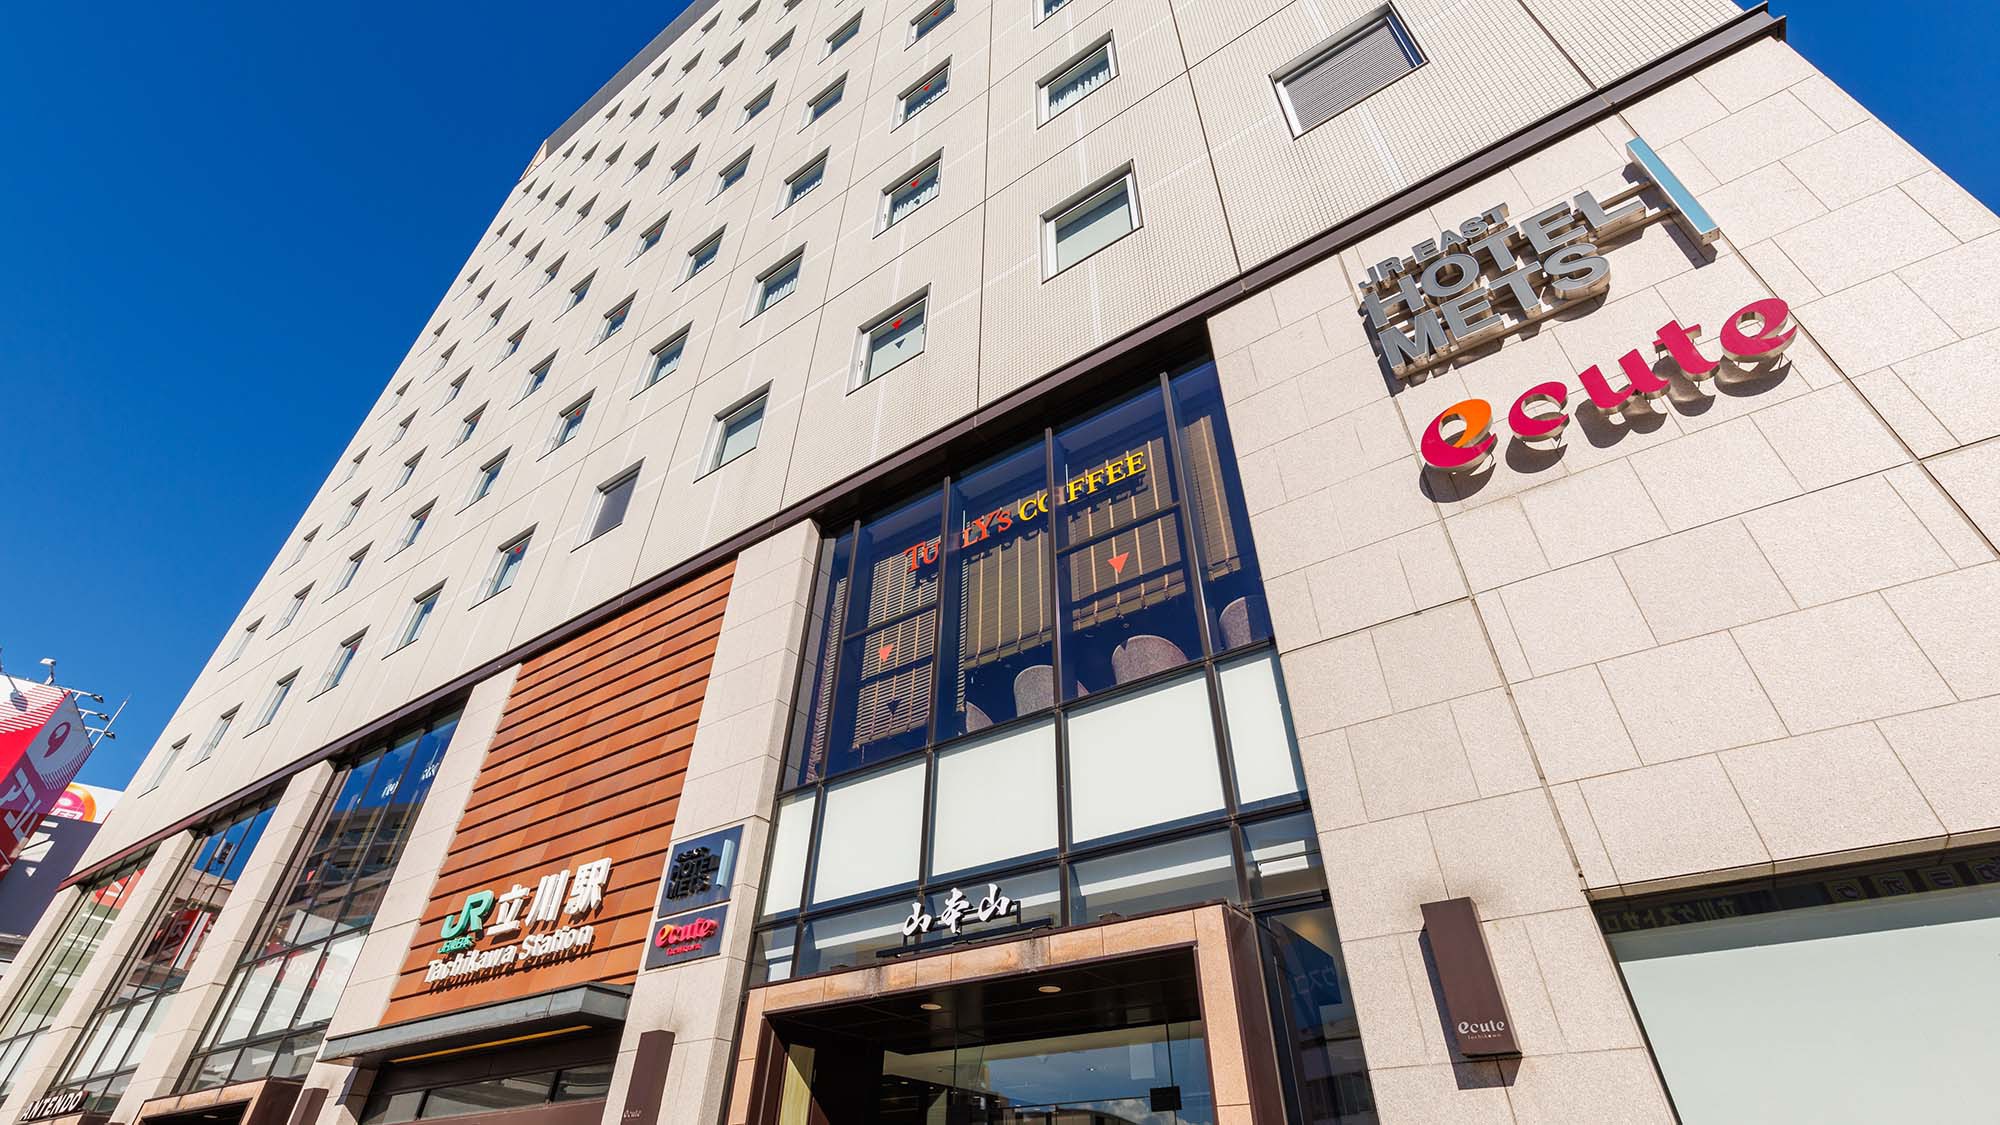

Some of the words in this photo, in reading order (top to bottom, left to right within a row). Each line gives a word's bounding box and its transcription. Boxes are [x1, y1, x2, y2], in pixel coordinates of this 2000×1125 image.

[1364, 190, 1647, 329] HOTEL
[1379, 243, 1610, 371] METS
[1420, 298, 1798, 469] ecute
[905, 508, 1013, 573] TULY'S
[441, 889, 495, 939] JR
[486, 857, 613, 936] 立川駅
[424, 945, 518, 983] Tachikawa
[518, 924, 594, 960] Station
[655, 917, 719, 948] ecute
[1458, 1020, 1505, 1034] ecute
[20, 1090, 83, 1121] ANTENDO
